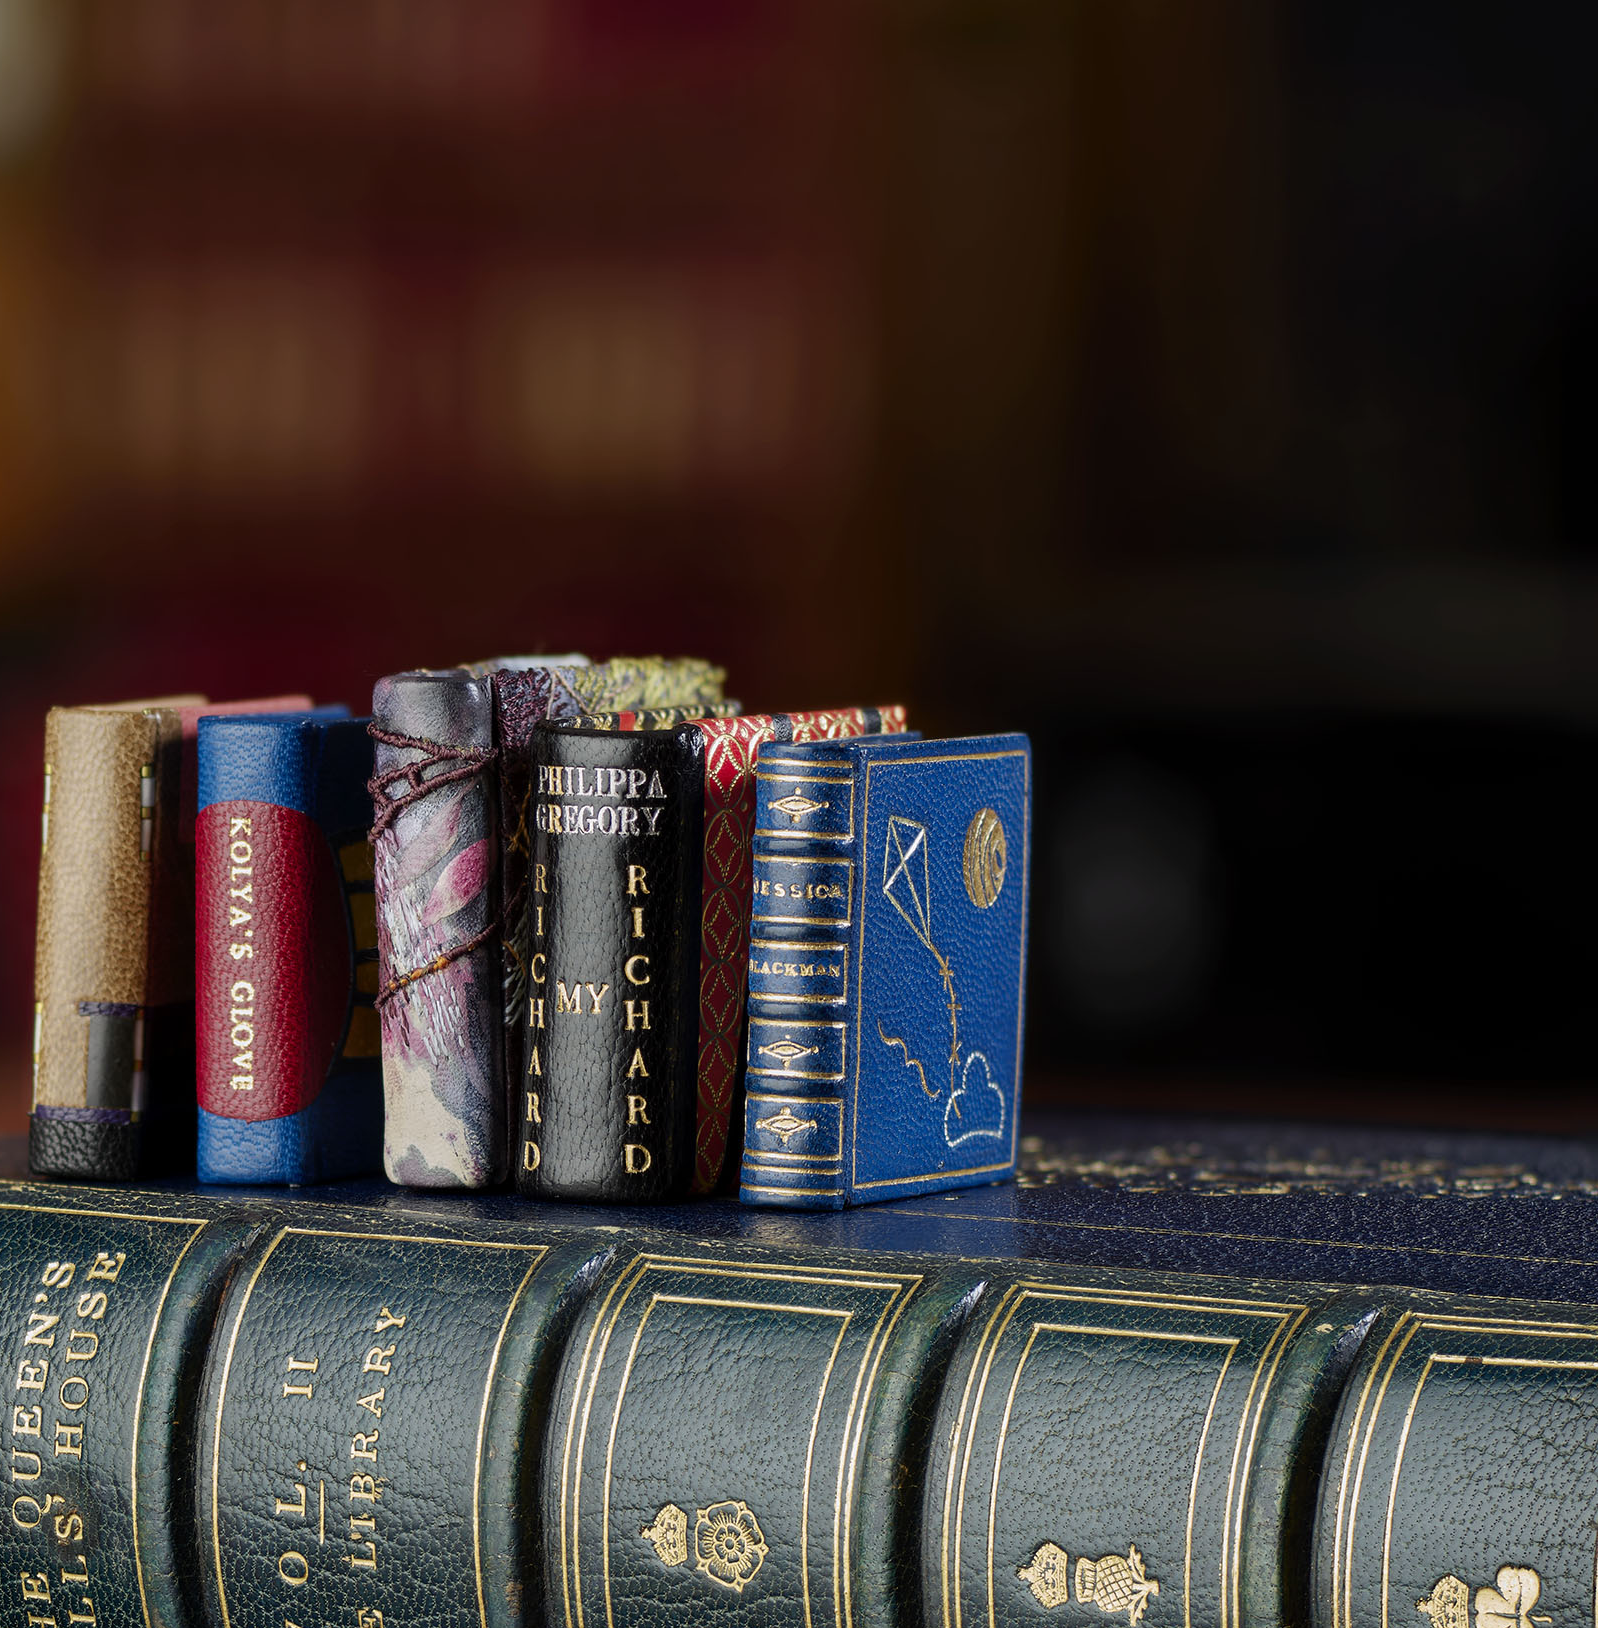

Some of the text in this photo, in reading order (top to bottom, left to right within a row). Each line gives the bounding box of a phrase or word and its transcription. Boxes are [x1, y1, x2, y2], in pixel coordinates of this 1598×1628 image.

[536, 804, 664, 836] GREGORY
[538, 765, 667, 799] PHILIPPA
[229, 817, 255, 1091] KOLYA'S GLOVE
[523, 863, 548, 1173] RICHARD
[556, 980, 610, 1015] MY
[624, 864, 652, 1174] RICHARD
[12, 1261, 76, 1529] QUEEN'S
[54, 1252, 127, 1460] HOUSE
[283, 1356, 319, 1400] II
[350, 1307, 407, 1571] LIBRARY
